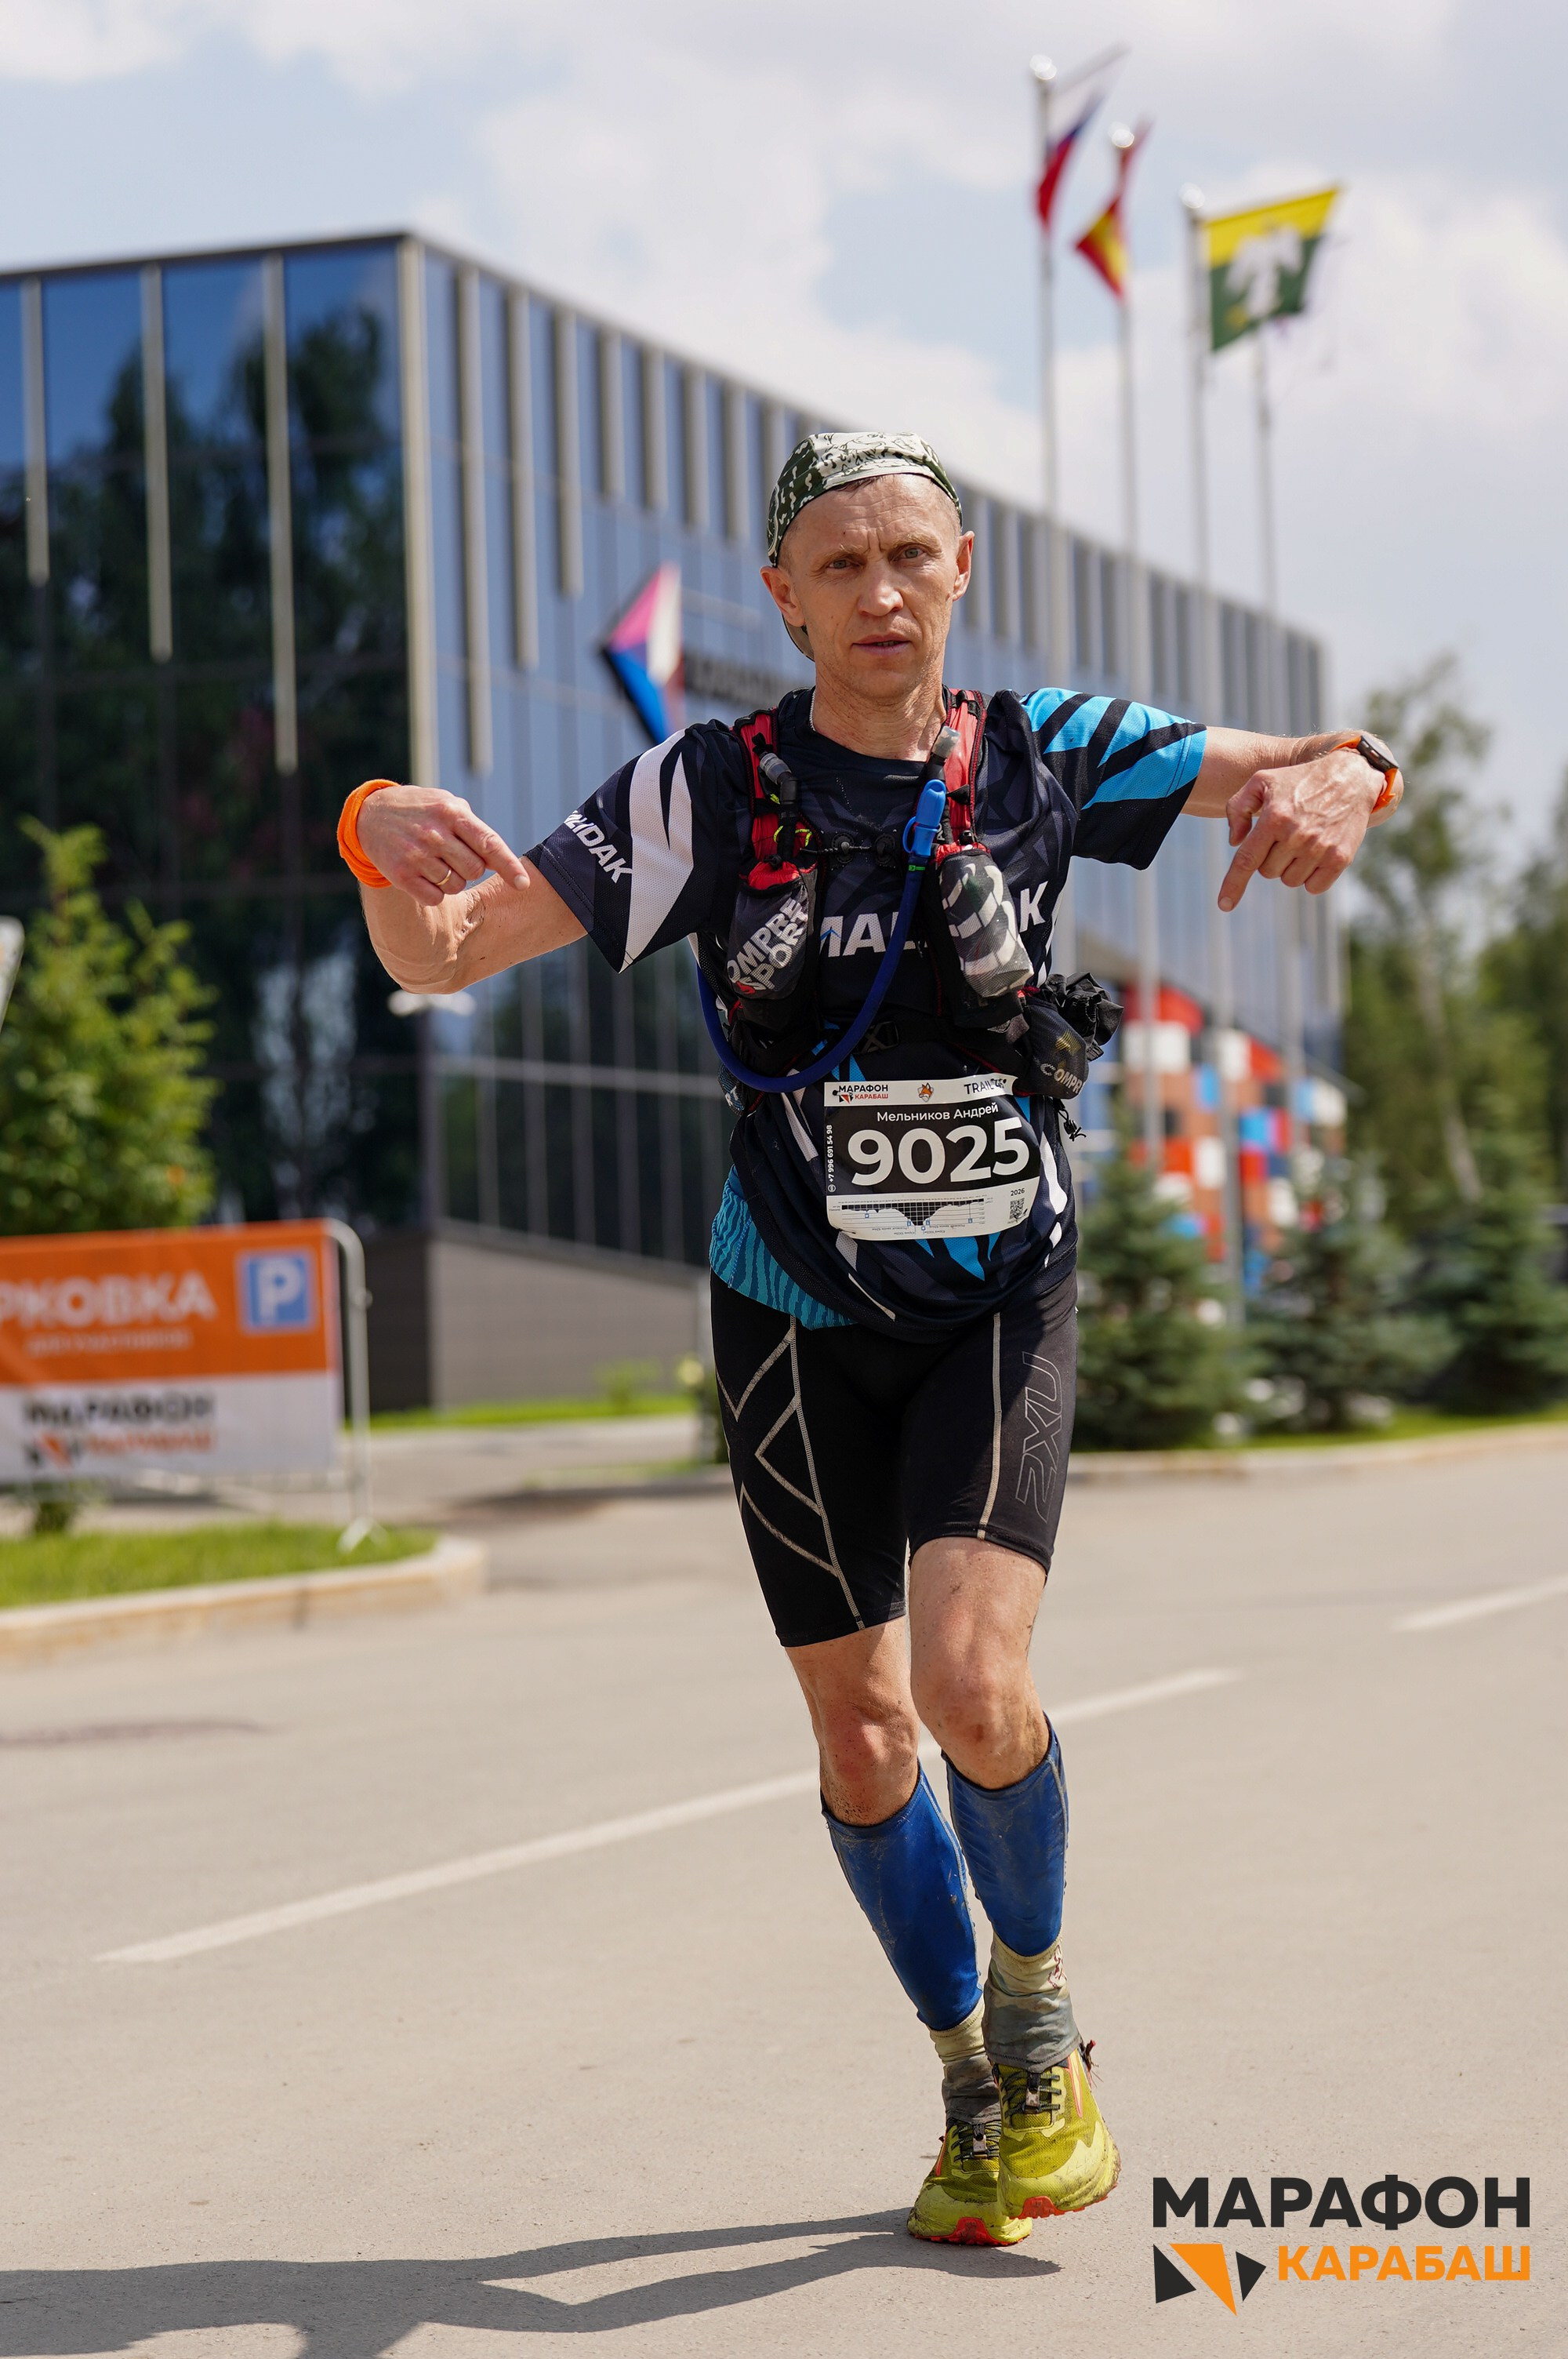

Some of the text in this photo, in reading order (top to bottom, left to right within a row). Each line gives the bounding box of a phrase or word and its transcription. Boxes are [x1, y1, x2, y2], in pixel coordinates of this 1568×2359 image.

[727, 897, 802, 983] OMPRE
[839, 1084, 888, 1092] МАРАФОН
[964, 1079, 994, 1095] TRAIL
[1040, 1063, 1083, 1095] COMPR
[877, 1102, 999, 1121] Мельников Андрей
[826, 1125, 833, 1134] 98
[848, 1117, 1030, 1187] 9025
[1011, 1187, 1025, 1197] 2026
[1015, 1350, 1062, 1524] 2XU
